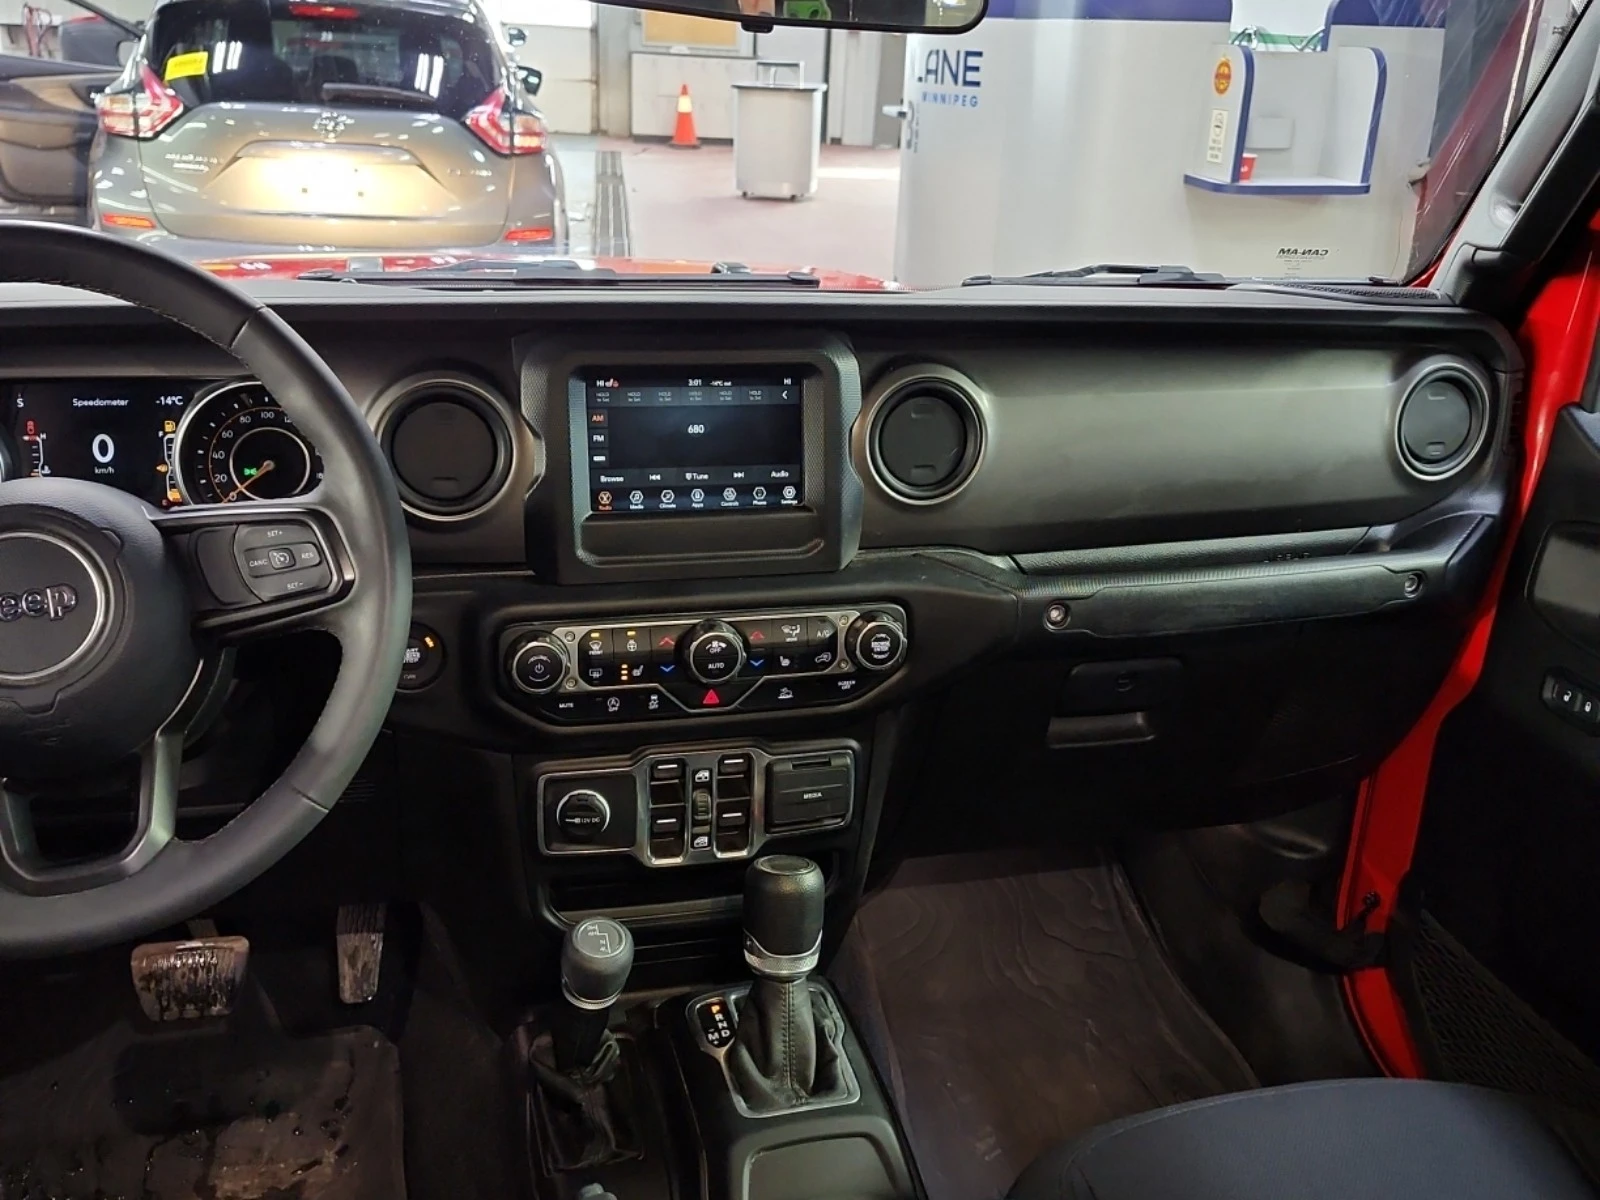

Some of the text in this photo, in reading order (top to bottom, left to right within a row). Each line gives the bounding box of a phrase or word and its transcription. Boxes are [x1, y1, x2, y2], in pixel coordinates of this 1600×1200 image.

[917, 49, 984, 87] ANE
[17, 398, 24, 407] S
[73, 398, 129, 407] Speedometer
[239, 415, 251, 423] 80
[261, 411, 275, 419] 100
[687, 425, 705, 433] 680
[221, 430, 233, 438] 60
[92, 434, 114, 463] 0
[212, 451, 225, 459] 40
[215, 474, 227, 483] 20
[249, 559, 268, 567] CANC
[0, 584, 77, 621] eep
[816, 630, 830, 638] A/C
[714, 1013, 724, 1022] R
[717, 1020, 728, 1030] N
[707, 1032, 720, 1041] M
[721, 1029, 731, 1038] D
